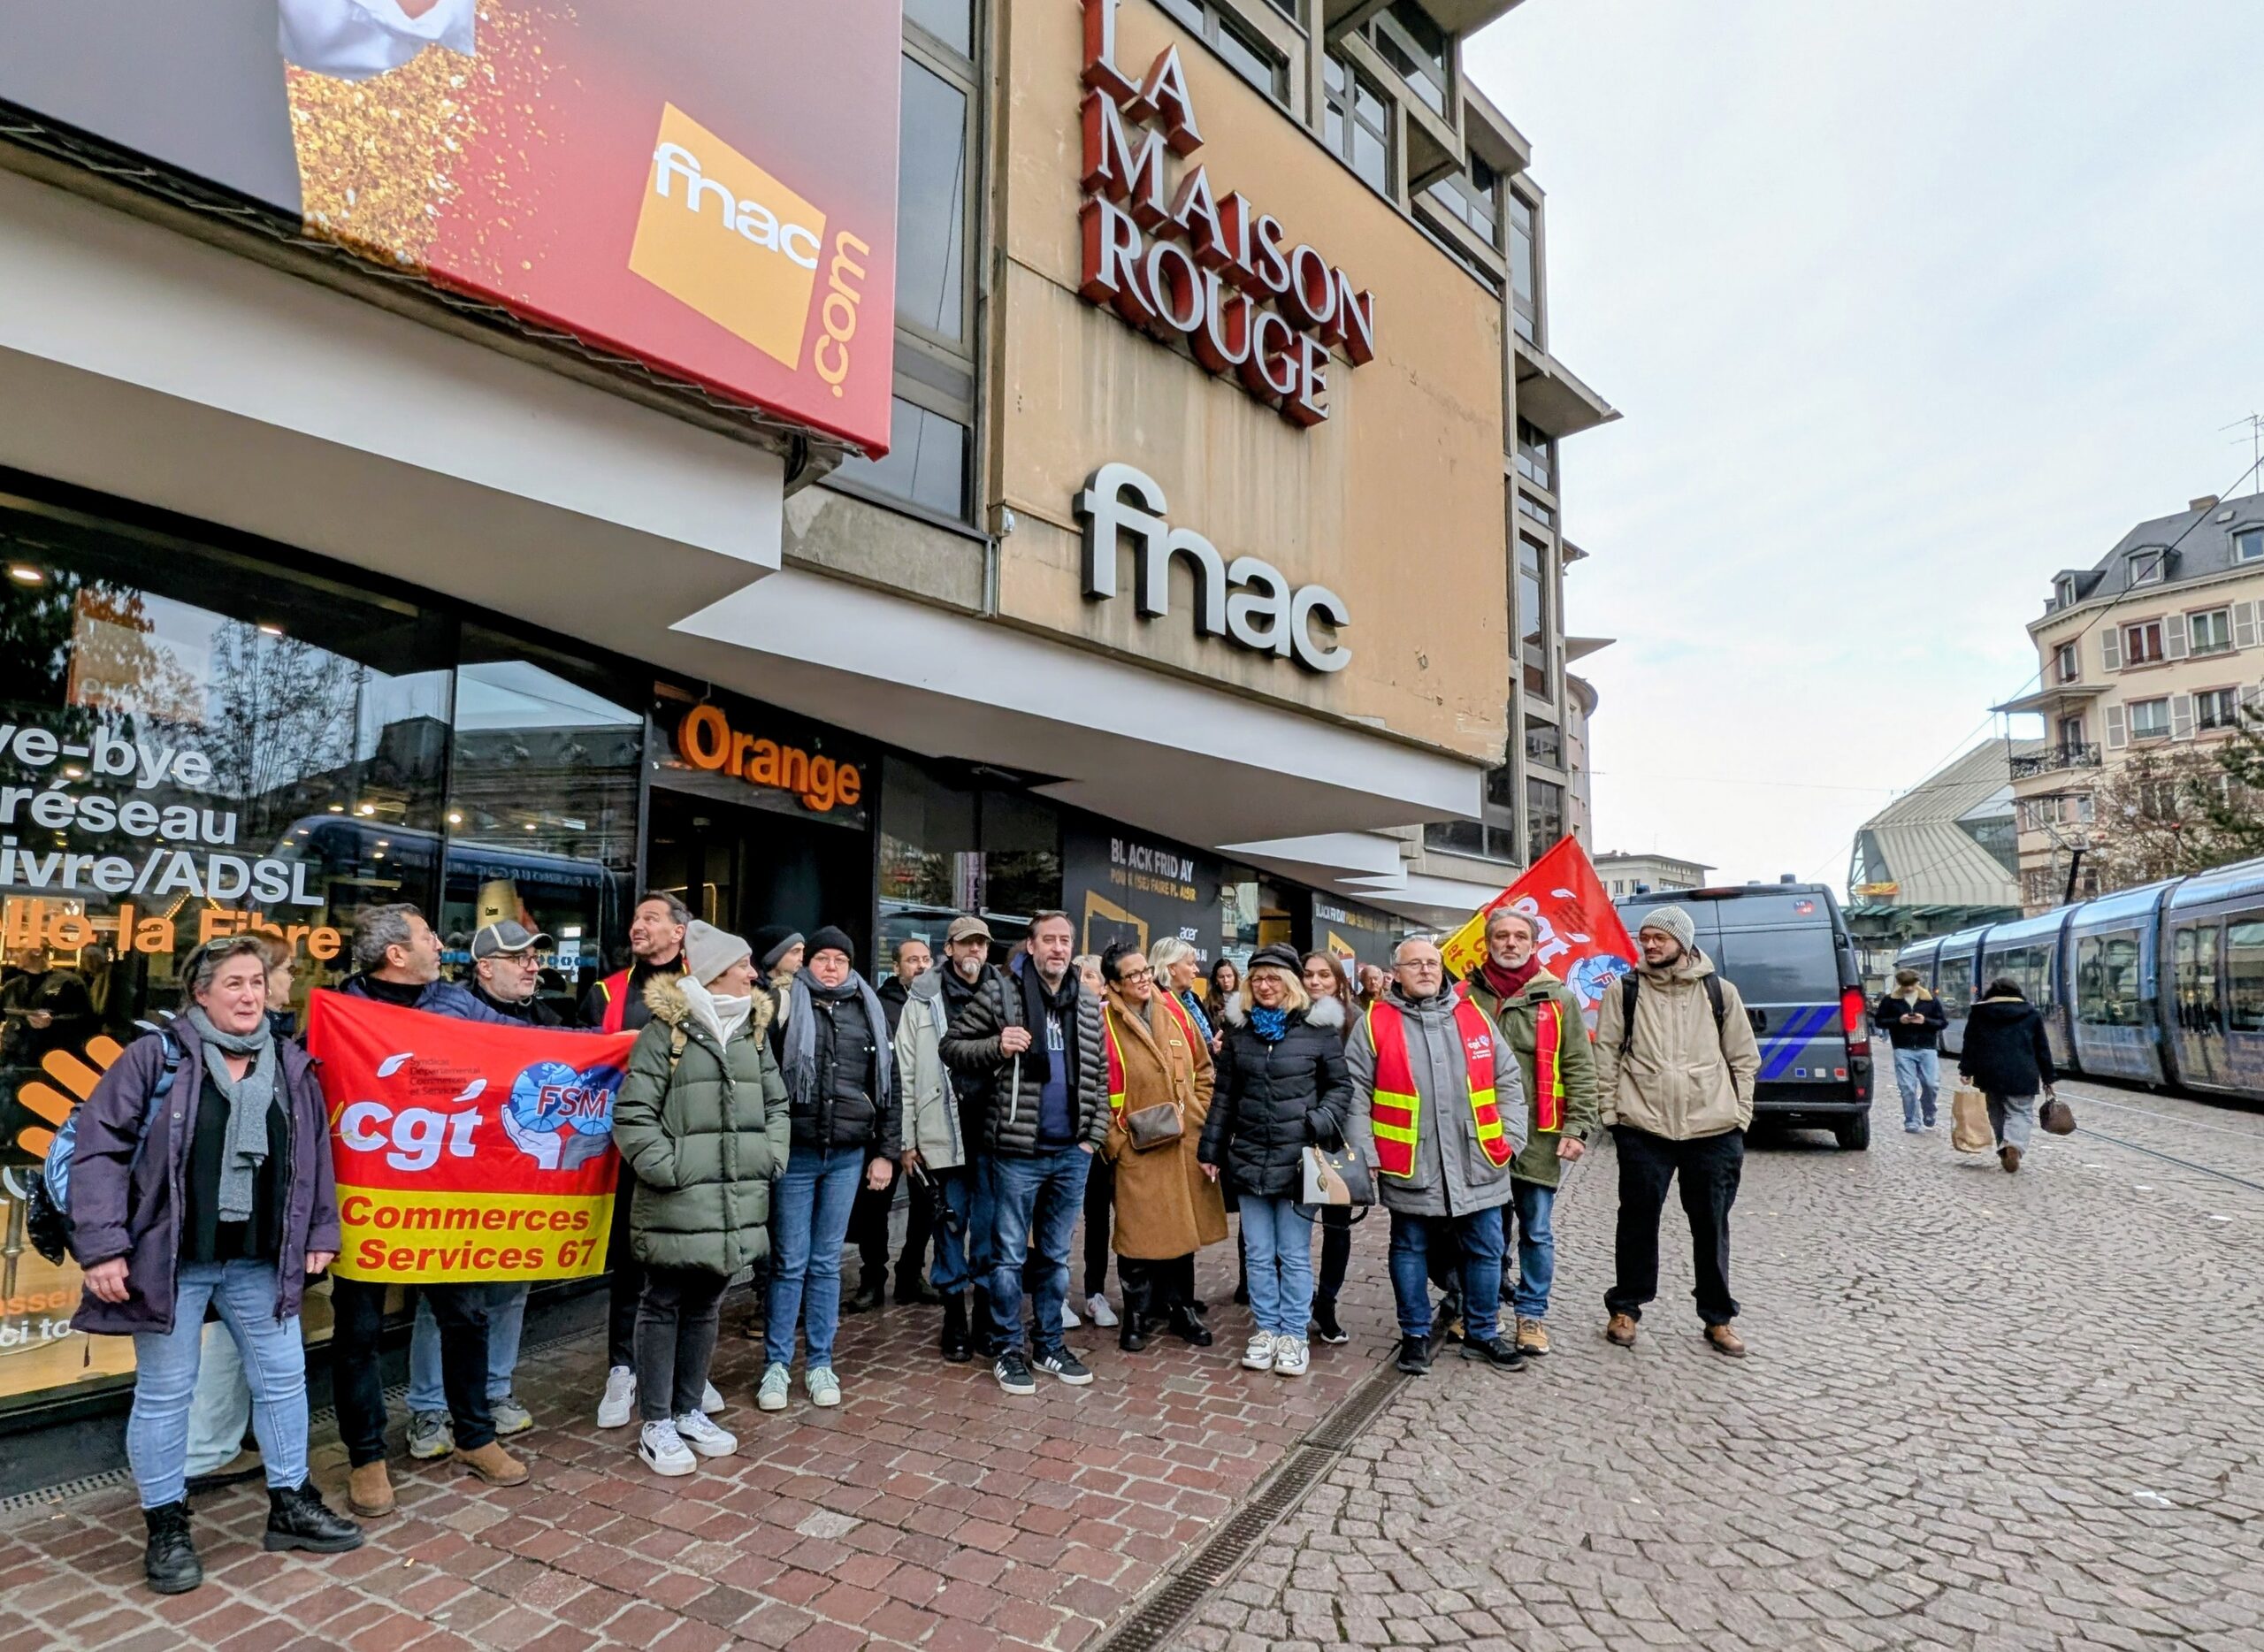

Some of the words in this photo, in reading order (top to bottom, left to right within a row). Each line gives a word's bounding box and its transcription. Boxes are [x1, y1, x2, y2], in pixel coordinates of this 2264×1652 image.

[1094, 0, 1204, 145] LA
[652, 141, 822, 271] fnac
[1095, 87, 1376, 359] MAISON
[814, 230, 870, 398] .com
[1095, 195, 1331, 420] ROUGE
[1082, 462, 1353, 672] fnac
[679, 704, 862, 813] Orange
[0, 780, 237, 845] réseau
[1111, 837, 1152, 872] BLACK
[1154, 851, 1194, 883] FRIDAY
[0, 898, 92, 951] llo
[118, 904, 175, 953] la
[1179, 926, 1198, 942] acer
[339, 1099, 485, 1173] cgt
[536, 1083, 609, 1120] FSM
[341, 1195, 591, 1232] Commerces
[356, 1238, 545, 1272] Services
[557, 1238, 598, 1268] 67
